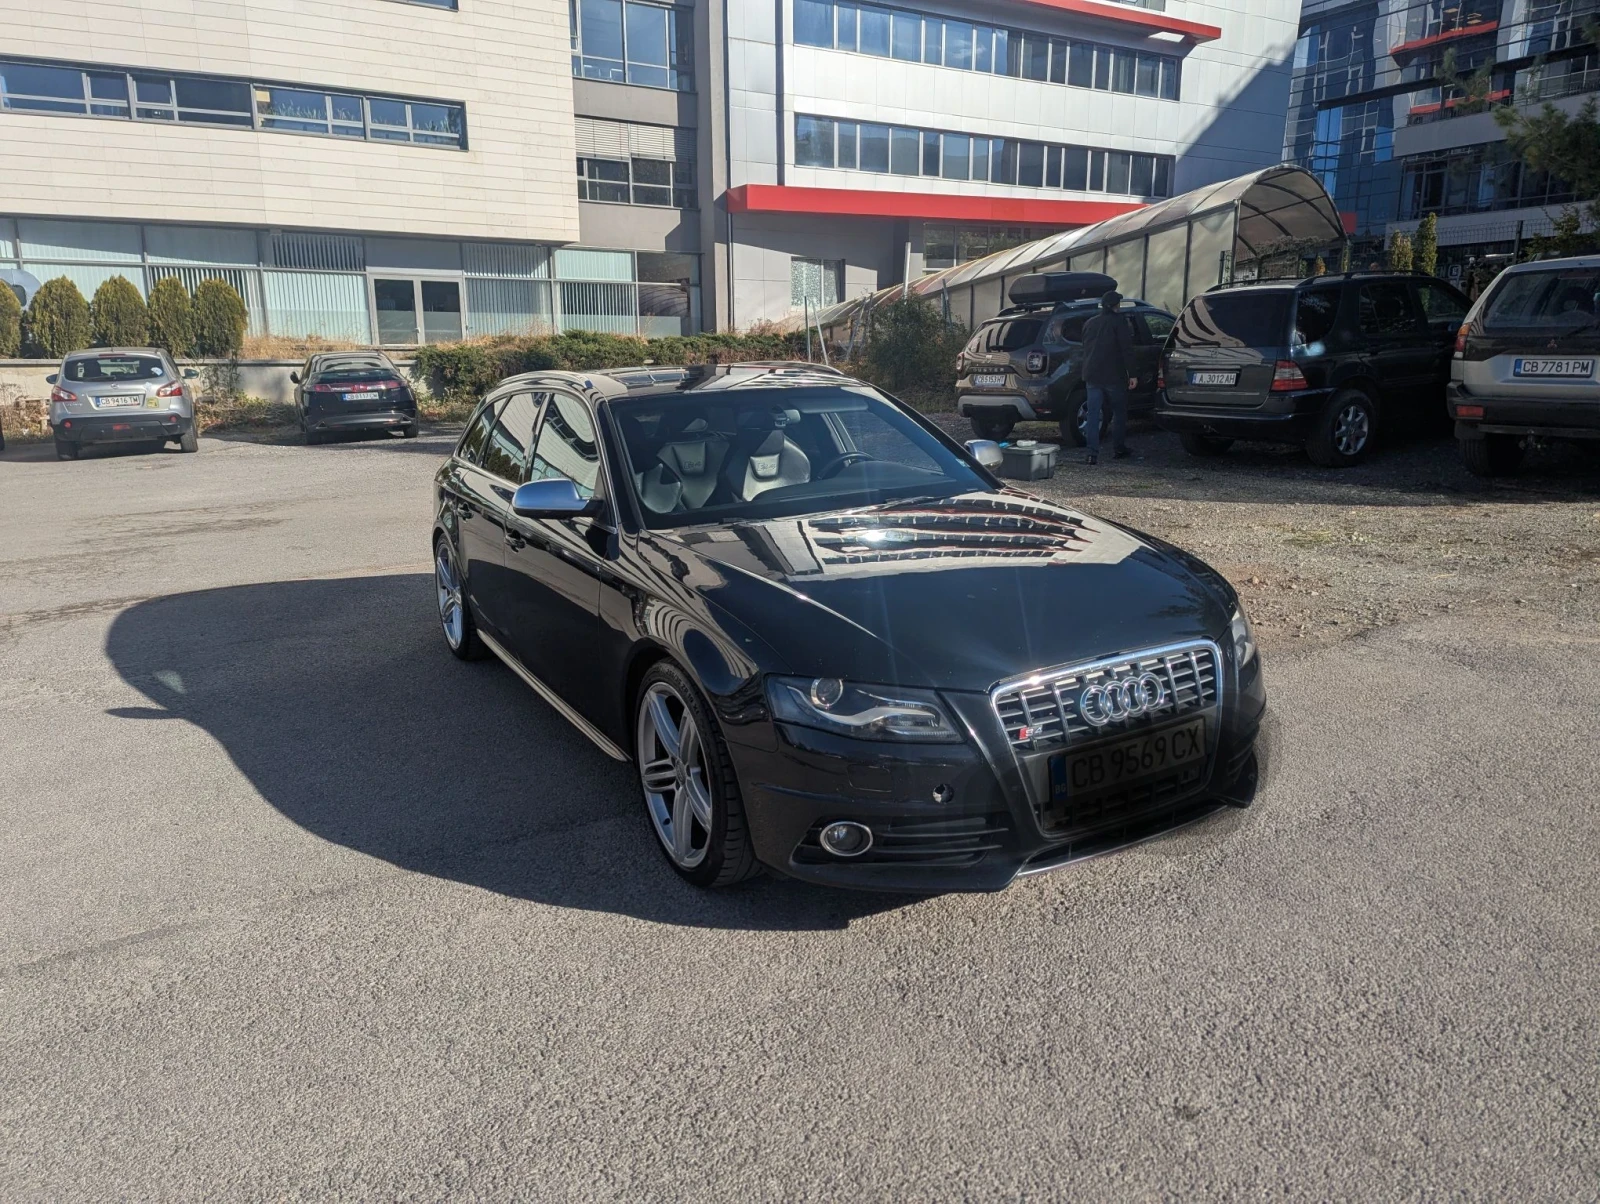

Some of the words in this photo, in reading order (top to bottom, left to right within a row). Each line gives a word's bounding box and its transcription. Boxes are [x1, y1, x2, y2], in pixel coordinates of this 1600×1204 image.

[1522, 361, 1539, 373] CB
[1541, 361, 1570, 373] 7781
[1572, 361, 1590, 373] PM
[1071, 754, 1106, 789] CB
[1110, 736, 1167, 779] 9569
[1172, 725, 1201, 760] CX
